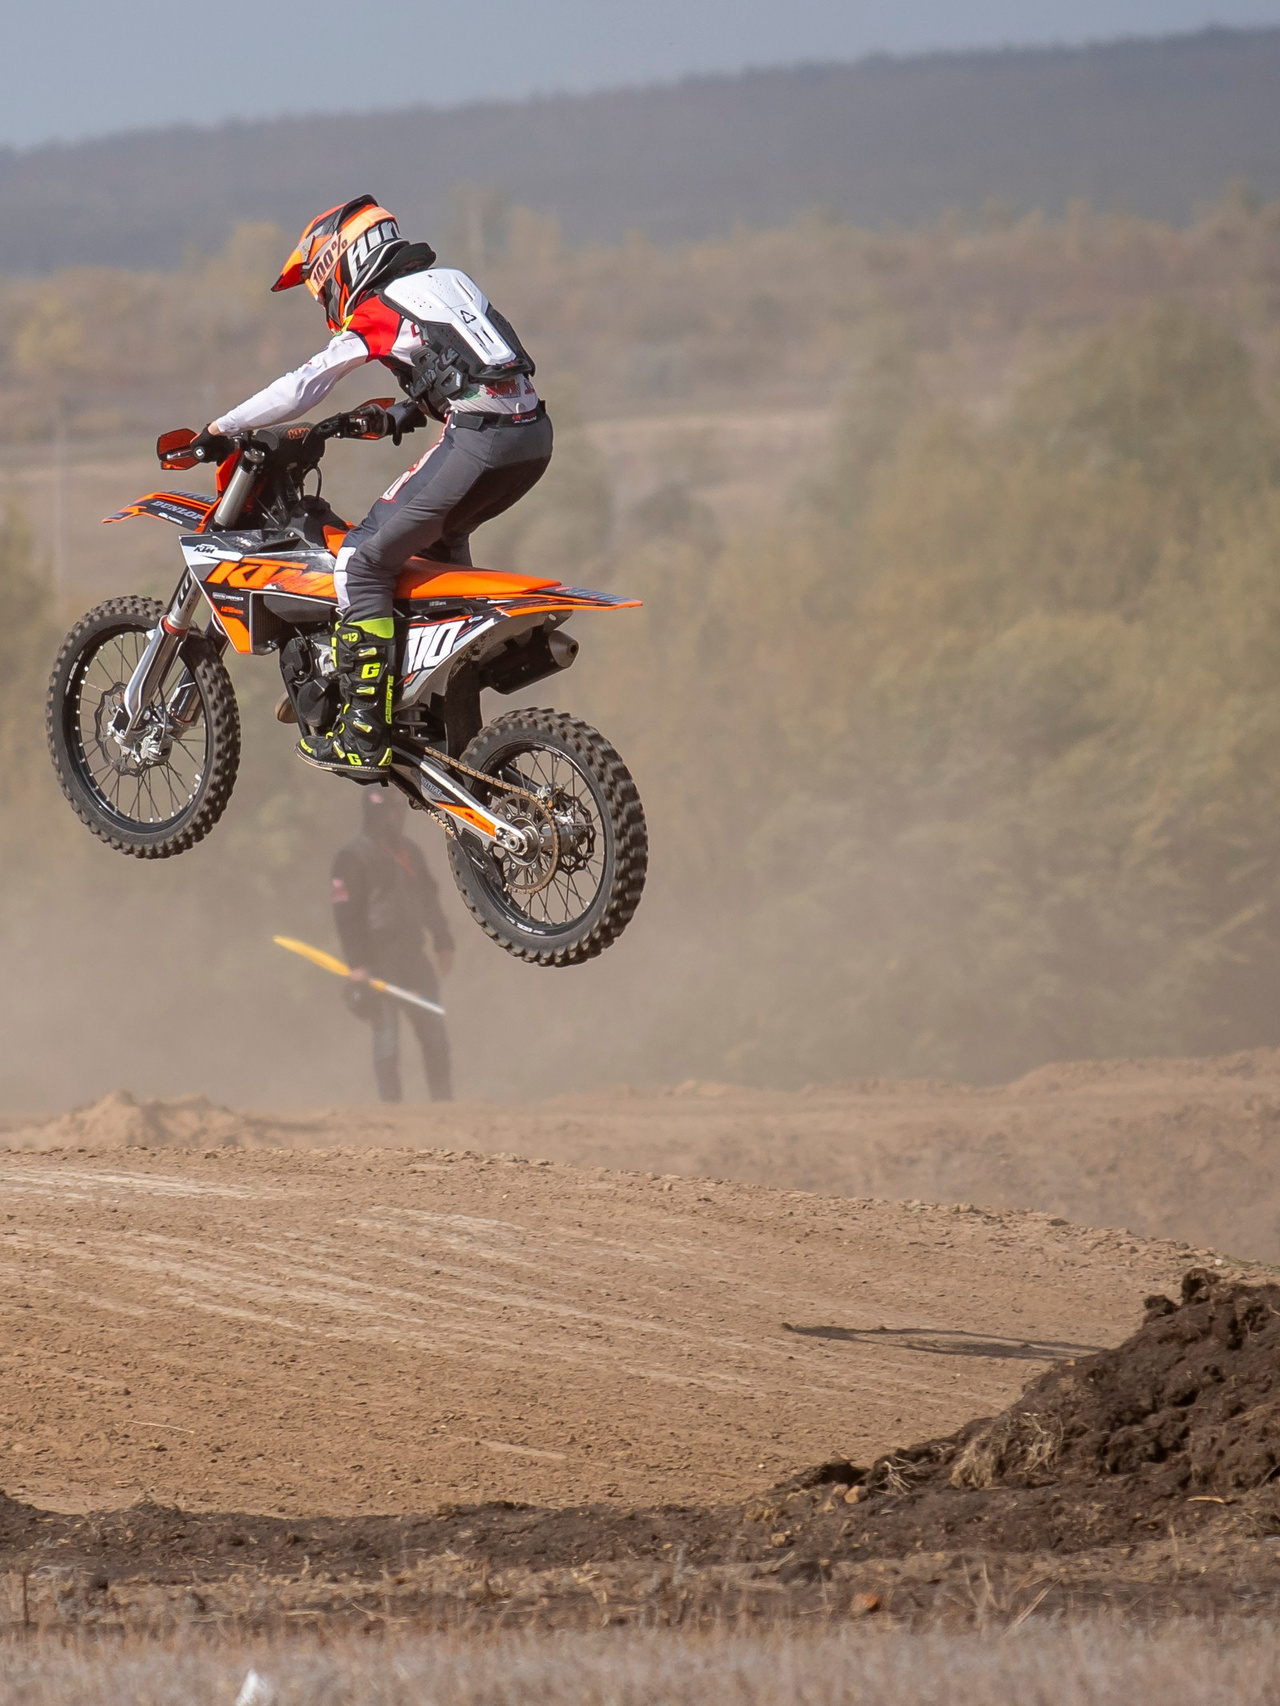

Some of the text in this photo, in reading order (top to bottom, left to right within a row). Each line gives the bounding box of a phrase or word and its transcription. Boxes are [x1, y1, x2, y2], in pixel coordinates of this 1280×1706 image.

[312, 234, 349, 285] 100%
[150, 500, 206, 521] DUNLOP
[194, 543, 218, 555] KTM
[406, 620, 466, 674] 110
[361, 662, 381, 679] G
